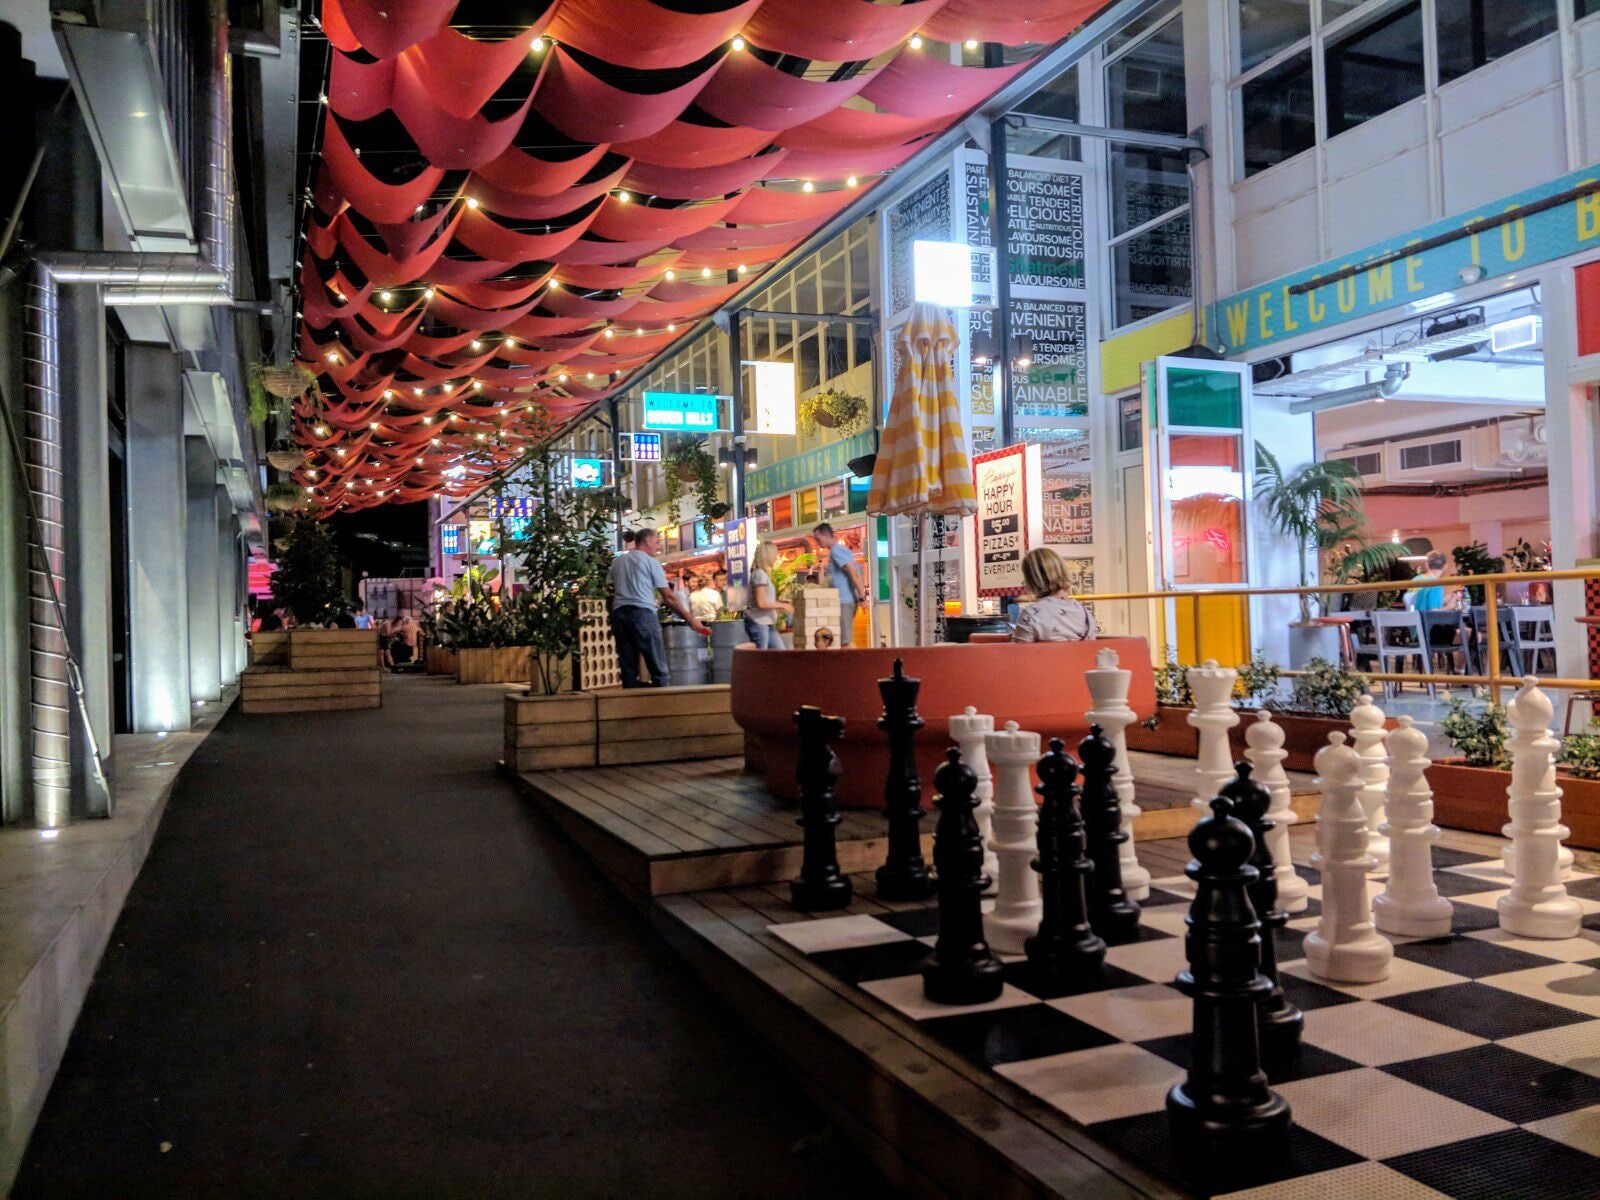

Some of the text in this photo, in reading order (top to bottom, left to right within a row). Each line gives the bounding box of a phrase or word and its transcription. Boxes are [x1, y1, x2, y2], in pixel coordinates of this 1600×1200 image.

[1008, 169, 1051, 182] BALANCED
[1028, 195, 1071, 210] TENDER
[1008, 204, 1071, 223] ELICIOUS
[1071, 176, 1084, 260] NUTRITIOUS
[1226, 238, 1425, 347] WELCOME
[1463, 203, 1526, 268] TO
[1024, 302, 1066, 313] BALANCED
[1067, 305, 1085, 314] DIET
[1039, 342, 1075, 354] TENDER
[1075, 315, 1086, 385] NUTRITIOUS
[983, 482, 1015, 501] HAPPY
[986, 499, 1013, 516] HOUR
[984, 563, 1019, 575] EVERYDAY
